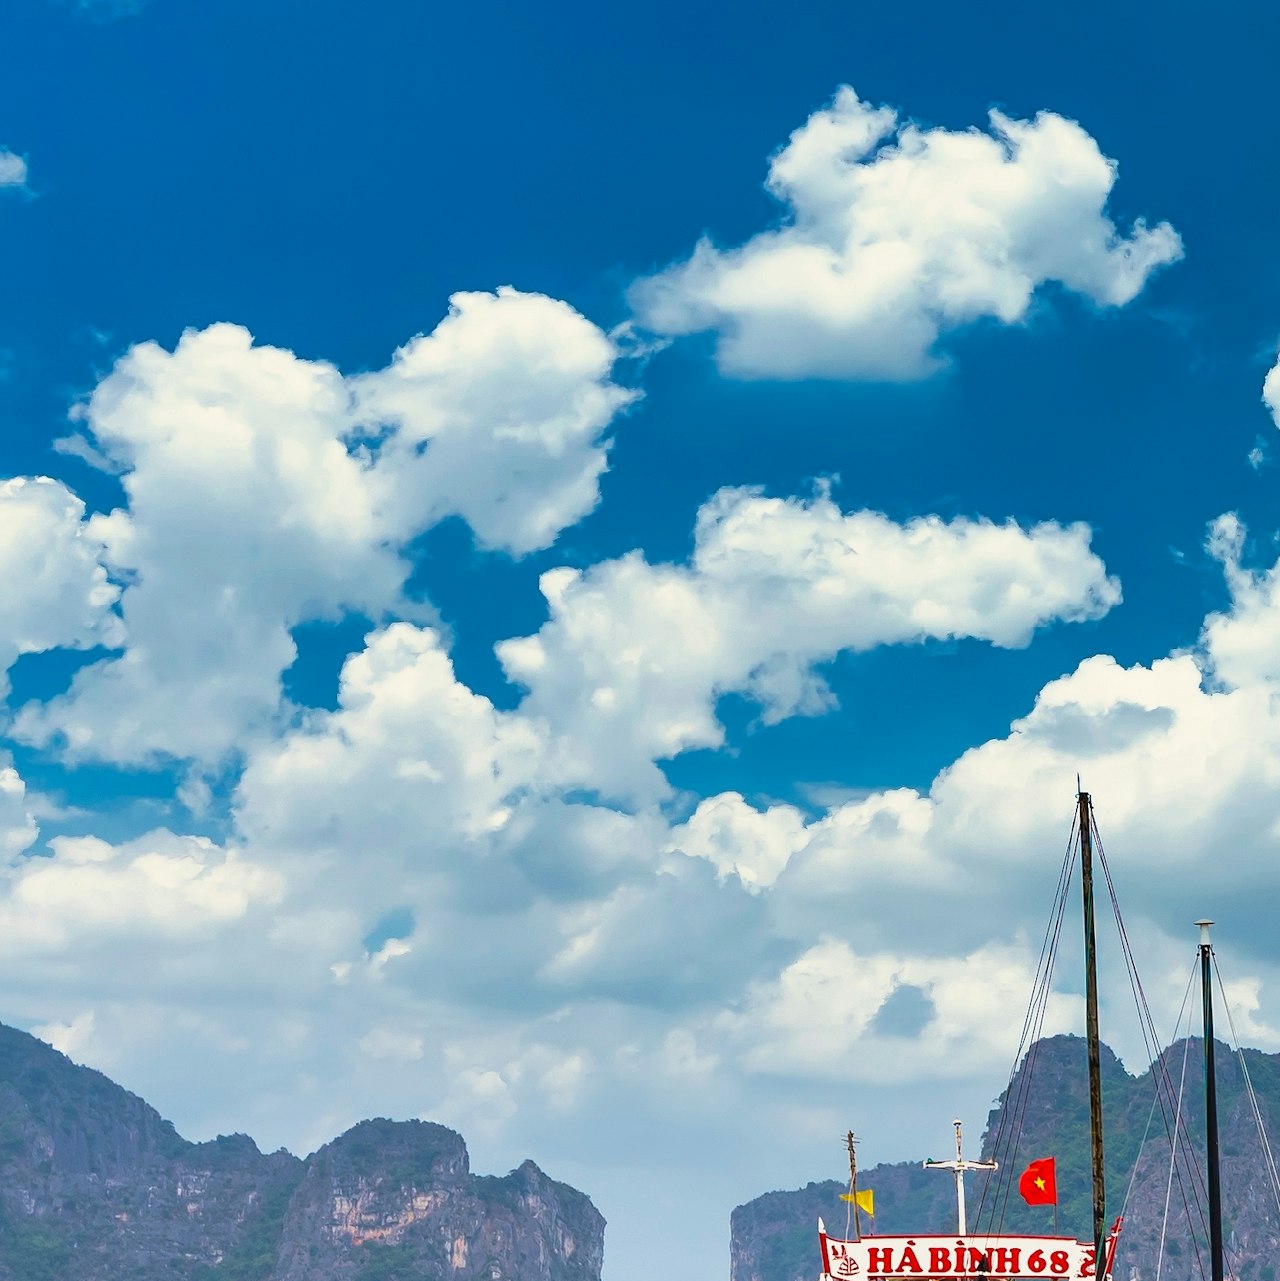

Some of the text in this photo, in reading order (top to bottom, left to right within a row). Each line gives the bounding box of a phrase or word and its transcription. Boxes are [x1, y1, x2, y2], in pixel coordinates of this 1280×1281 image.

[867, 1240, 1069, 1274] HÀ BÌNH 68
